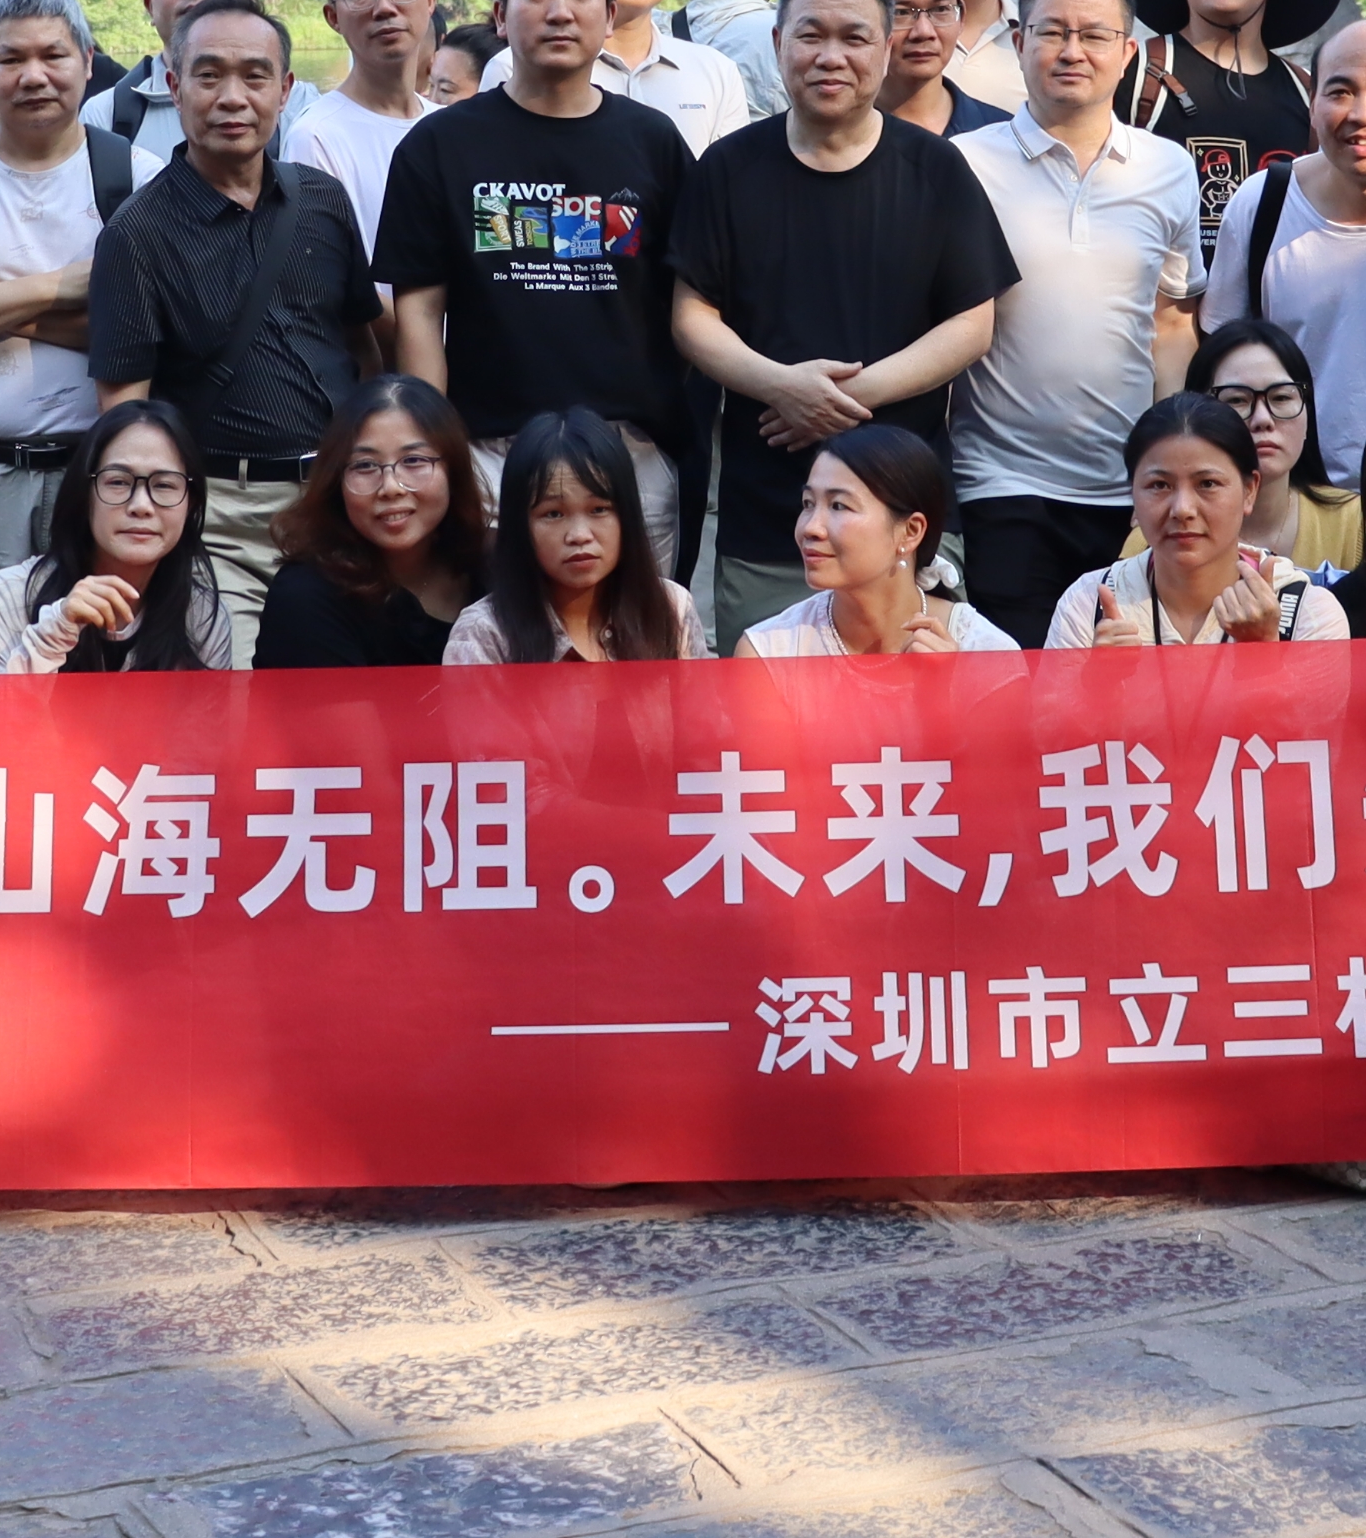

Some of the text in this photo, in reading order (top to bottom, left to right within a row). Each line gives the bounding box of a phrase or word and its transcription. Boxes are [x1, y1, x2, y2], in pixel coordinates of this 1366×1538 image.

[473, 182, 565, 202] CKAVOT
[493, 214, 512, 242] SPORT
[509, 262, 525, 270] The
[527, 262, 550, 270] Brand
[552, 263, 571, 272] With
[573, 264, 588, 272] The
[493, 272, 508, 280] Die
[510, 272, 557, 280] Weltmarke
[559, 272, 573, 281] Mit
[574, 274, 590, 282] Den
[524, 282, 534, 290] La
[535, 282, 566, 292] Marque
[568, 283, 584, 291] Aux
[585, 283, 590, 291] 3
